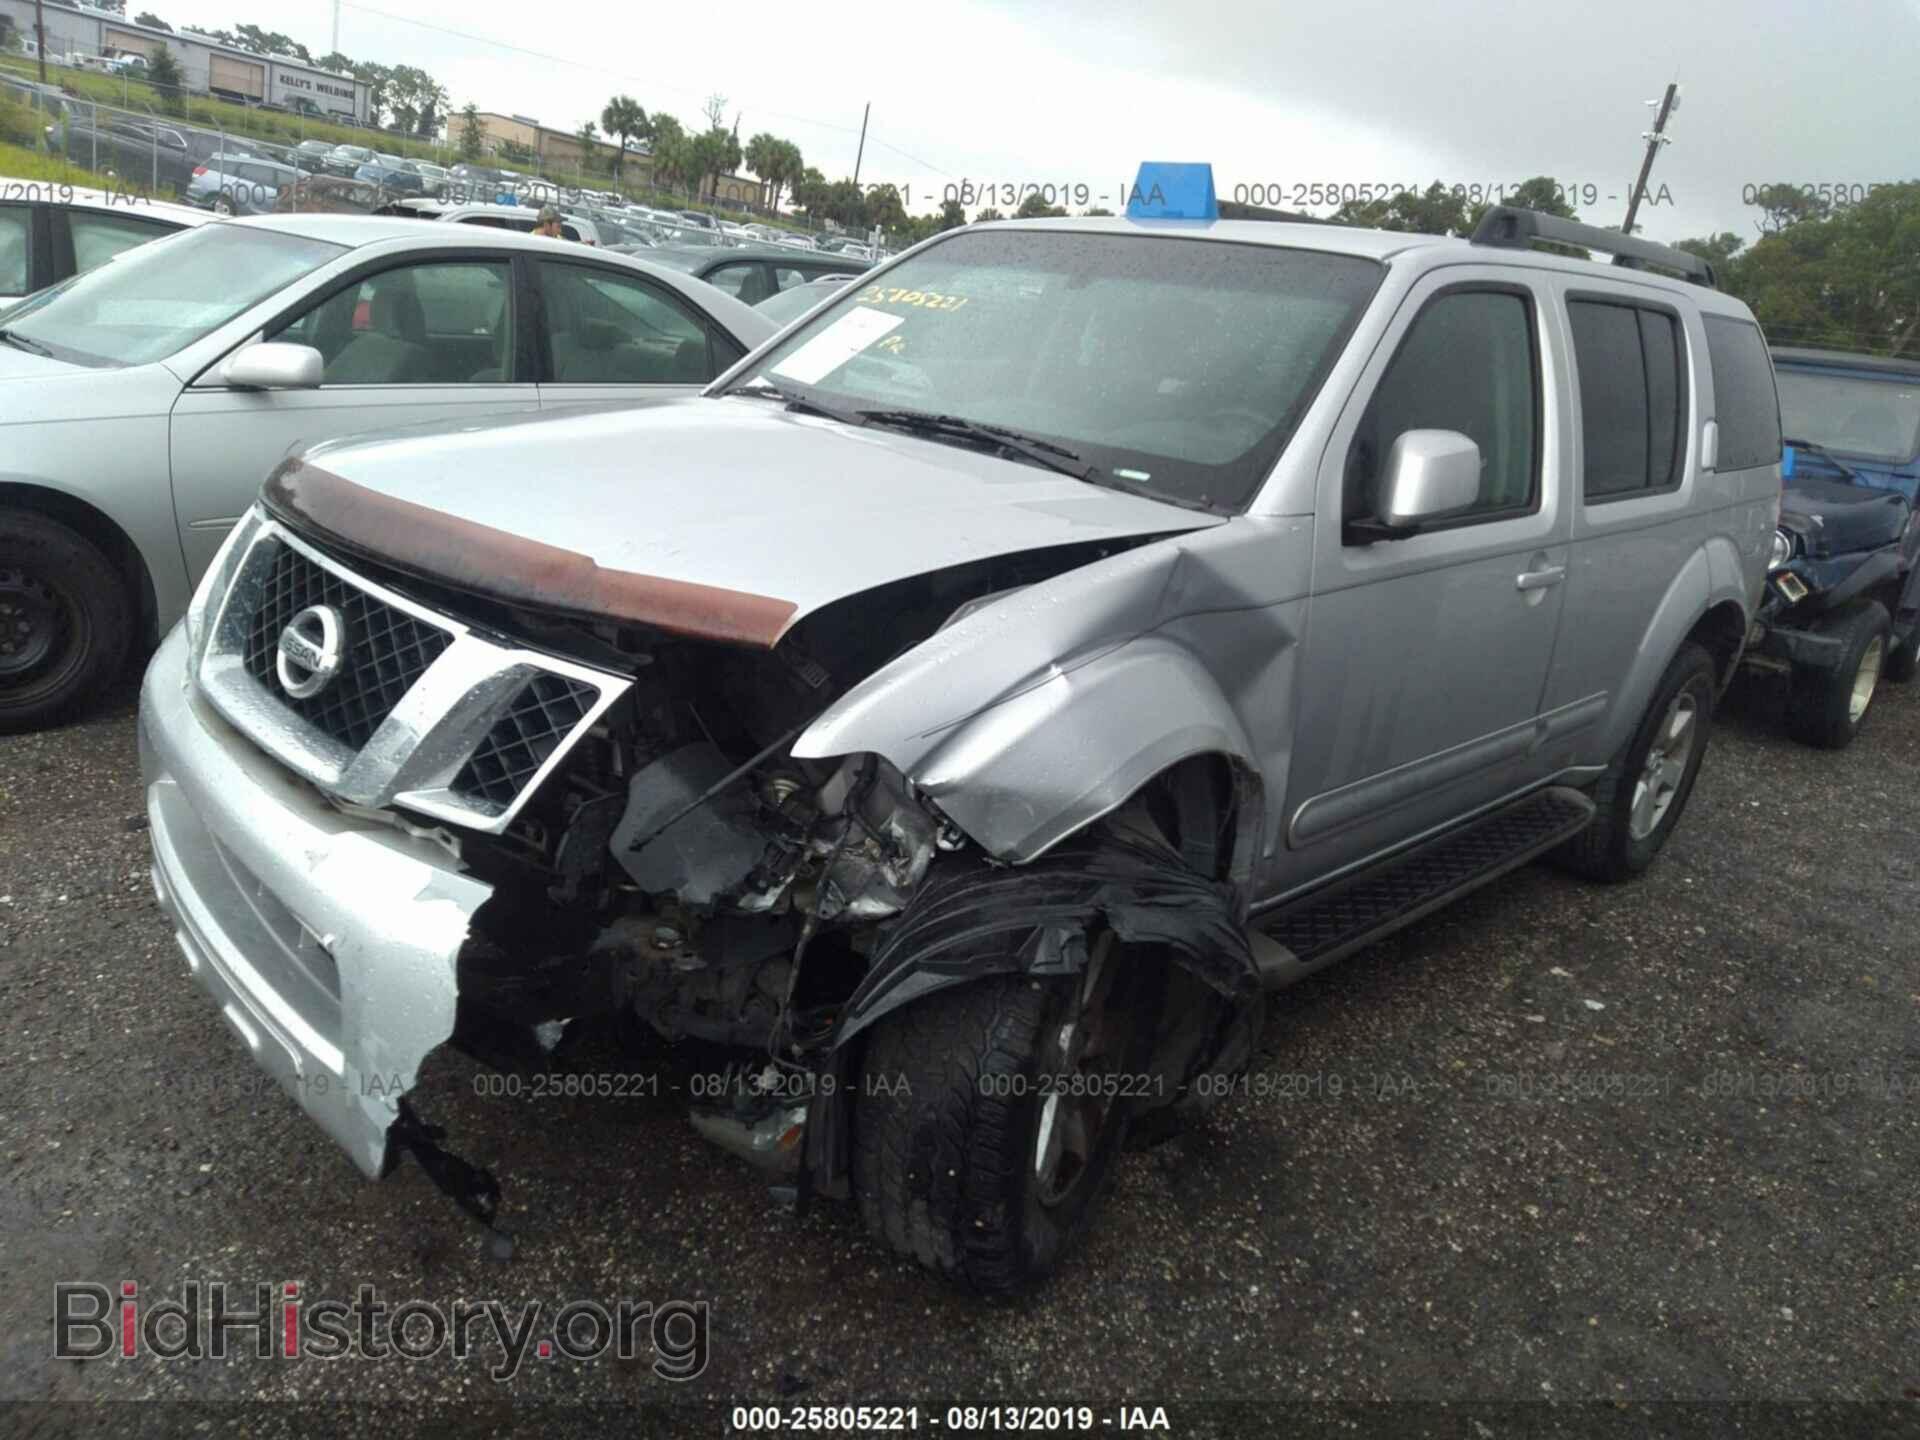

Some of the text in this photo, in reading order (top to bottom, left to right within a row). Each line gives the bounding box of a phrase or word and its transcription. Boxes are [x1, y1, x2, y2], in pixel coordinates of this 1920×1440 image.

[280, 74, 354, 99] KELLY'S WELDING
[282, 636, 321, 669] SSAN
